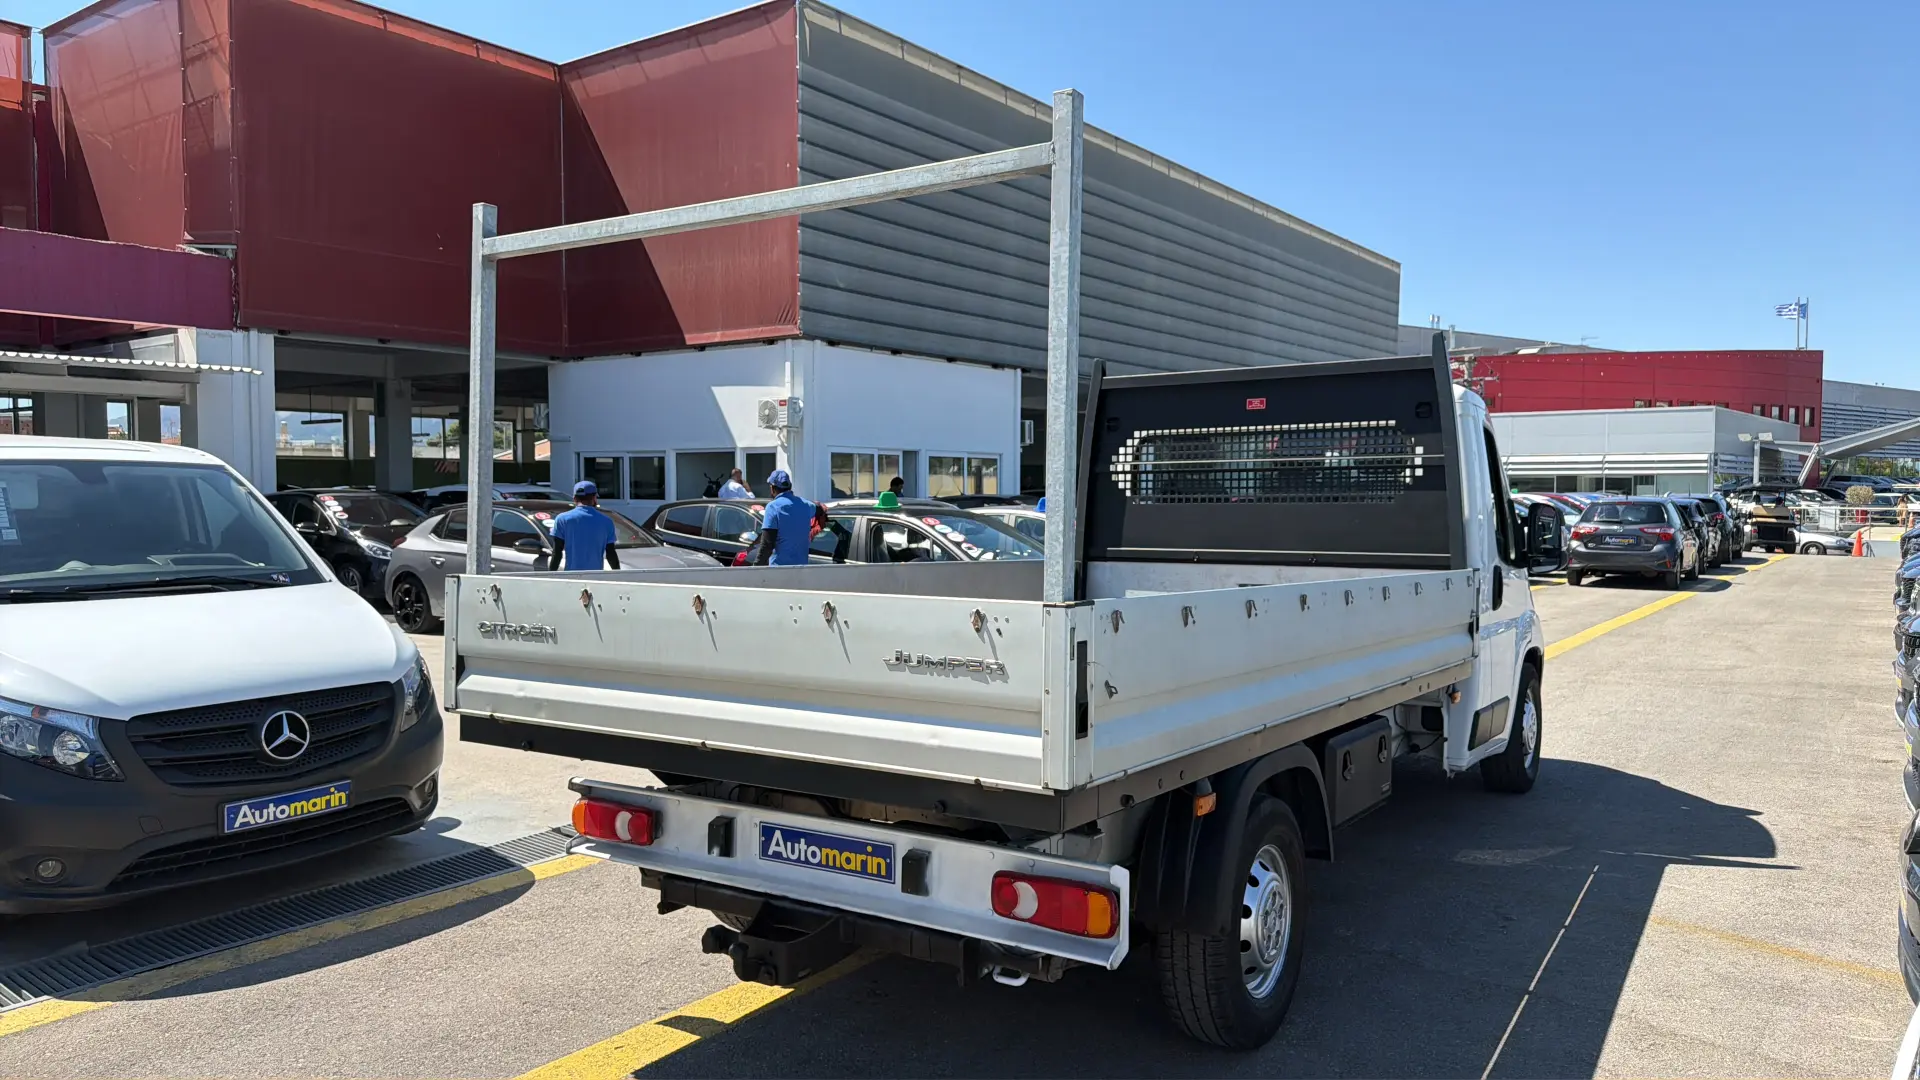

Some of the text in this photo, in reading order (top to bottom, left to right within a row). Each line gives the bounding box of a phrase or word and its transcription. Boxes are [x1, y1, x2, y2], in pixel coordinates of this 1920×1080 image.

[478, 620, 557, 639] CITROËN
[882, 648, 1006, 676] JUMPER
[234, 786, 346, 829] Automarin
[767, 829, 887, 876] Automarin
